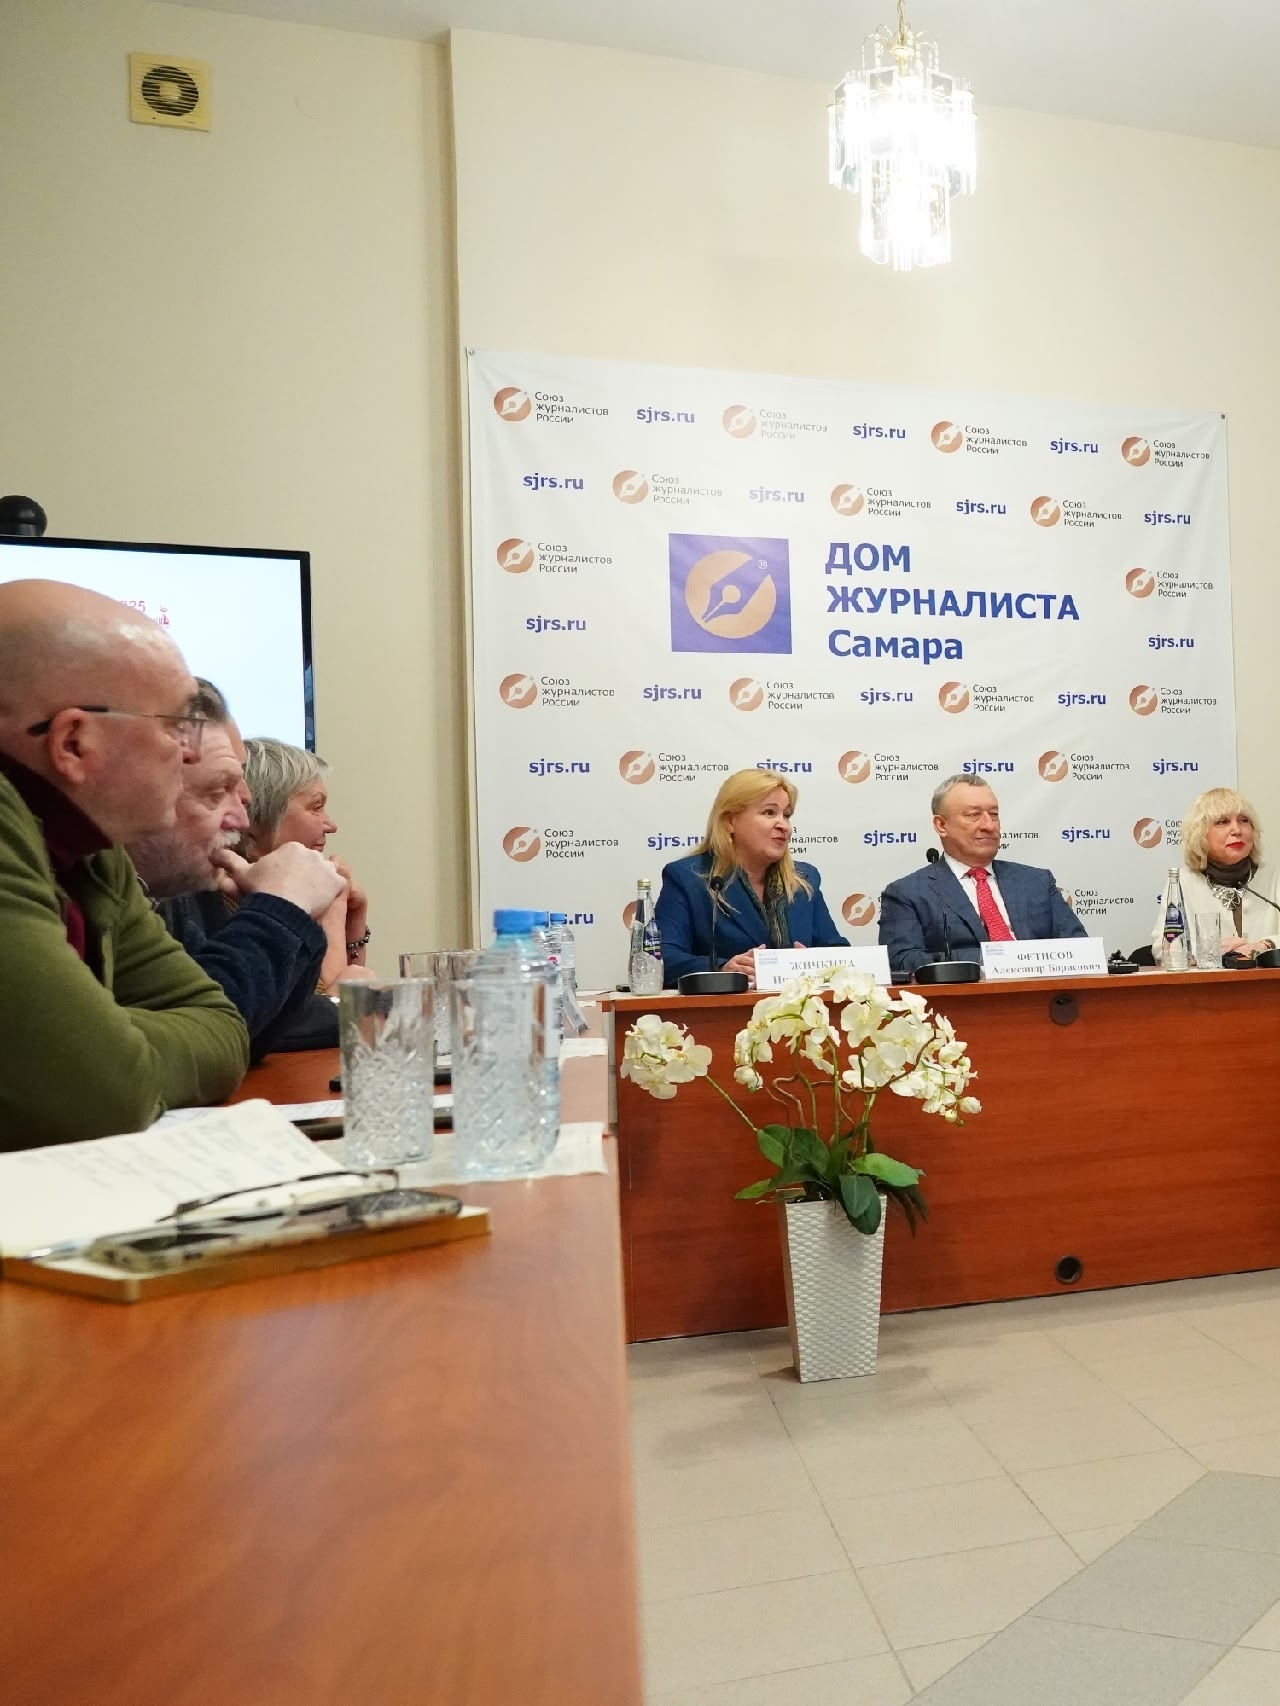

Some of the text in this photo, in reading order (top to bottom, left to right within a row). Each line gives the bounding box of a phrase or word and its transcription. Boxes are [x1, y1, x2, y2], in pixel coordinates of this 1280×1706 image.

[535, 392, 563, 402] Союз
[536, 404, 608, 415] журналистов
[537, 413, 573, 423] России
[637, 407, 694, 424] sjrs.ru
[853, 423, 905, 439] sjrs.ru
[965, 426, 989, 434] Союз
[966, 437, 1027, 446] журналистов
[1154, 440, 1175, 449] Союз
[967, 444, 998, 454] России
[1051, 439, 1098, 454] sjrs.ru
[1155, 450, 1209, 459] журналистов
[1155, 458, 1183, 467] России
[523, 473, 583, 490] sjrs.ru
[750, 486, 804, 503] sjrs.ru
[867, 488, 892, 496] Союз
[868, 499, 931, 508] журналистов
[957, 499, 1006, 515] sjrs.ru
[1063, 500, 1085, 508] Союз
[868, 508, 900, 516] России
[1064, 511, 1121, 519] журналистов
[1144, 511, 1190, 525] sjrs.ru
[1064, 519, 1094, 527] России
[538, 543, 567, 552] Союз
[539, 554, 612, 564] журналистов
[825, 543, 910, 575] ДОМ
[540, 564, 577, 573] России
[1158, 581, 1213, 589] журналистов
[1158, 589, 1186, 597] России
[827, 586, 1079, 620] ЖУРНАЛИСТА
[527, 616, 586, 633] sjrs.ru
[829, 629, 962, 665] Самара
[1149, 635, 1194, 650] sjrs.ru
[541, 677, 570, 685] Союз
[542, 689, 614, 698] журналистов
[644, 685, 701, 701] sjrs.ru
[768, 692, 834, 702] журналистов
[861, 688, 913, 705] sjrs.ru
[543, 698, 579, 706] России
[974, 696, 1034, 704] журналистов
[1058, 692, 1106, 707] sjrs.ru
[768, 701, 802, 709] России
[659, 753, 686, 761] Союз
[874, 753, 899, 761] Союз
[529, 759, 589, 776] sjrs.ru
[660, 764, 729, 773] журналистов
[875, 764, 939, 773] журналистов
[963, 759, 1014, 774] sjrs.ru
[1072, 764, 1130, 772] журналистов
[1153, 759, 1198, 774] sjrs.ru
[544, 829, 573, 837] Союз
[1062, 828, 1110, 842] sjrs.ru
[788, 836, 839, 844] налистов
[864, 830, 916, 846] sjrs.ru
[545, 840, 618, 849] журналистов
[546, 850, 584, 858] России
[1075, 889, 1098, 897] Союз
[1076, 898, 1134, 907] журналистов
[1017, 951, 1074, 962] ФЕТИСОВ
